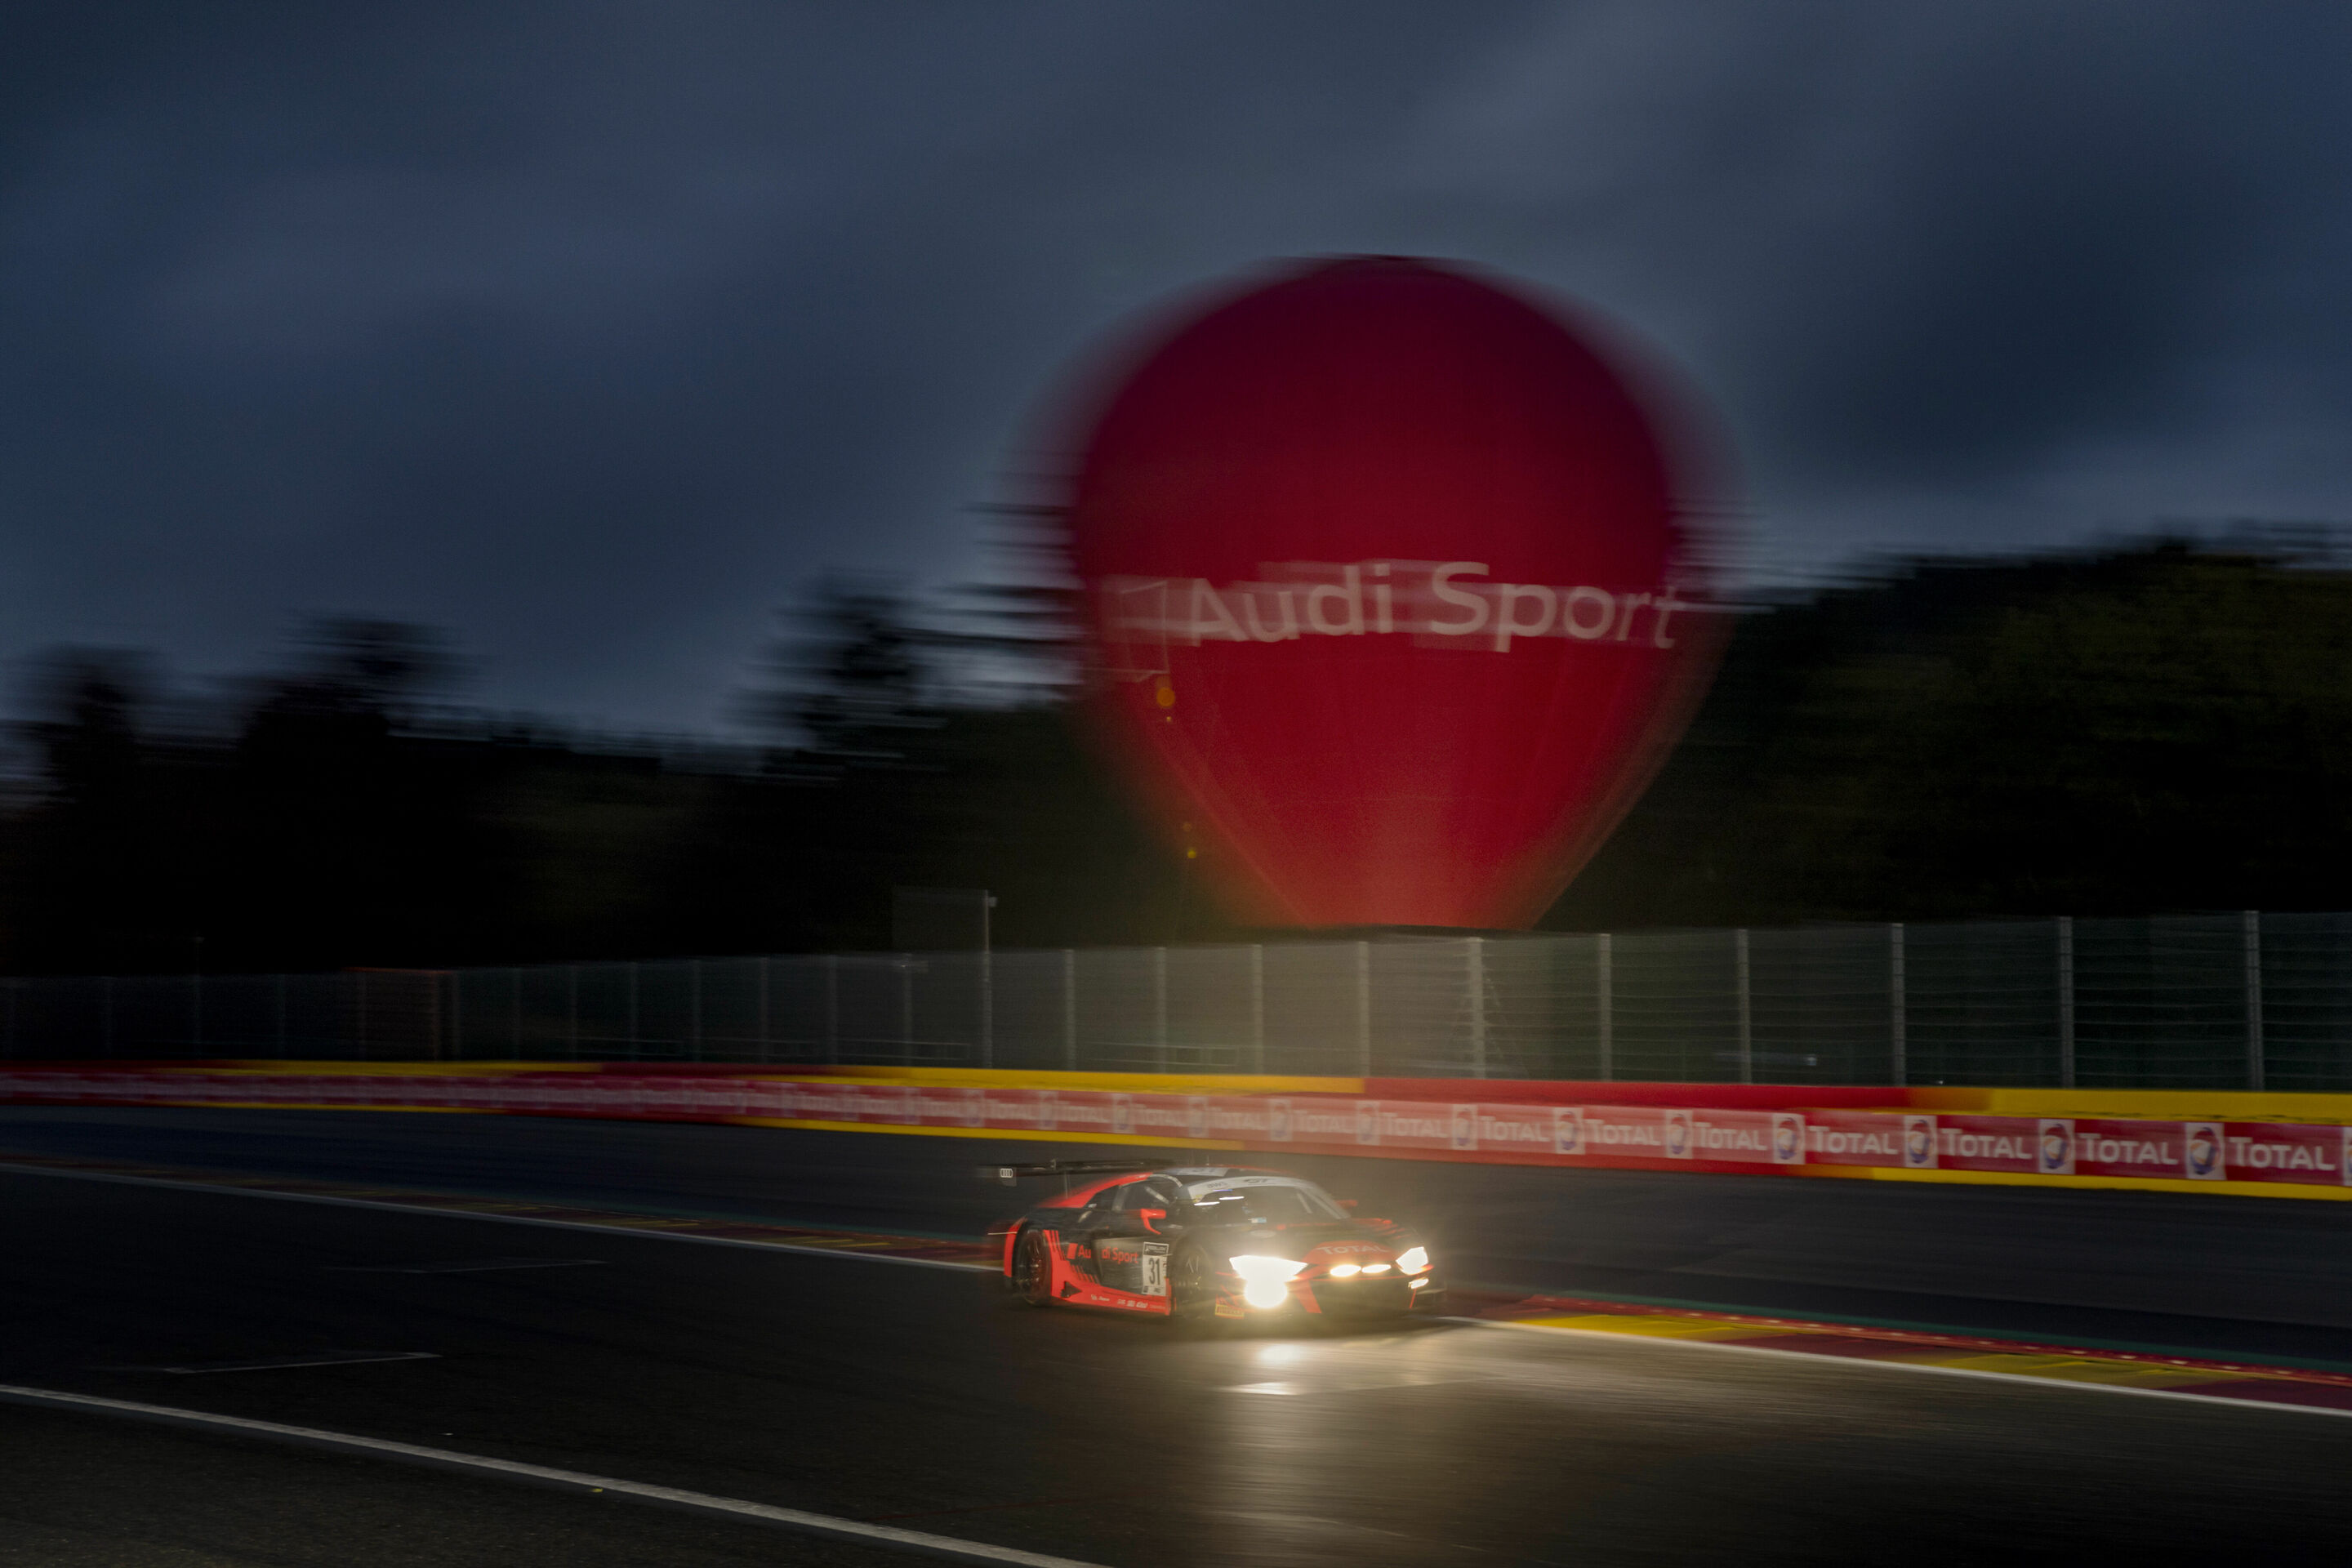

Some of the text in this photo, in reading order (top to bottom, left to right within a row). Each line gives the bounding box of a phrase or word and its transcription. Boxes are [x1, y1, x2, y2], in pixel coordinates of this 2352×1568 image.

[1188, 561, 1676, 653] Audi Sport
[1294, 1110, 1356, 1134] TOTAL
[1380, 1112, 1448, 1138] TOTAL
[1480, 1116, 1550, 1142] TOTAL
[1584, 1119, 1661, 1146] TOTAL
[1695, 1122, 1767, 1151] TOTAL
[1810, 1125, 1898, 1155] TOTAL
[1941, 1128, 2032, 1160] TOTAL
[2079, 1133, 2179, 1165] TOTAL
[2229, 1136, 2336, 1171] TOTAL
[1112, 1247, 1139, 1264] Sport
[1316, 1245, 1390, 1254] TOTAL
[1148, 1258, 1160, 1285] 31
